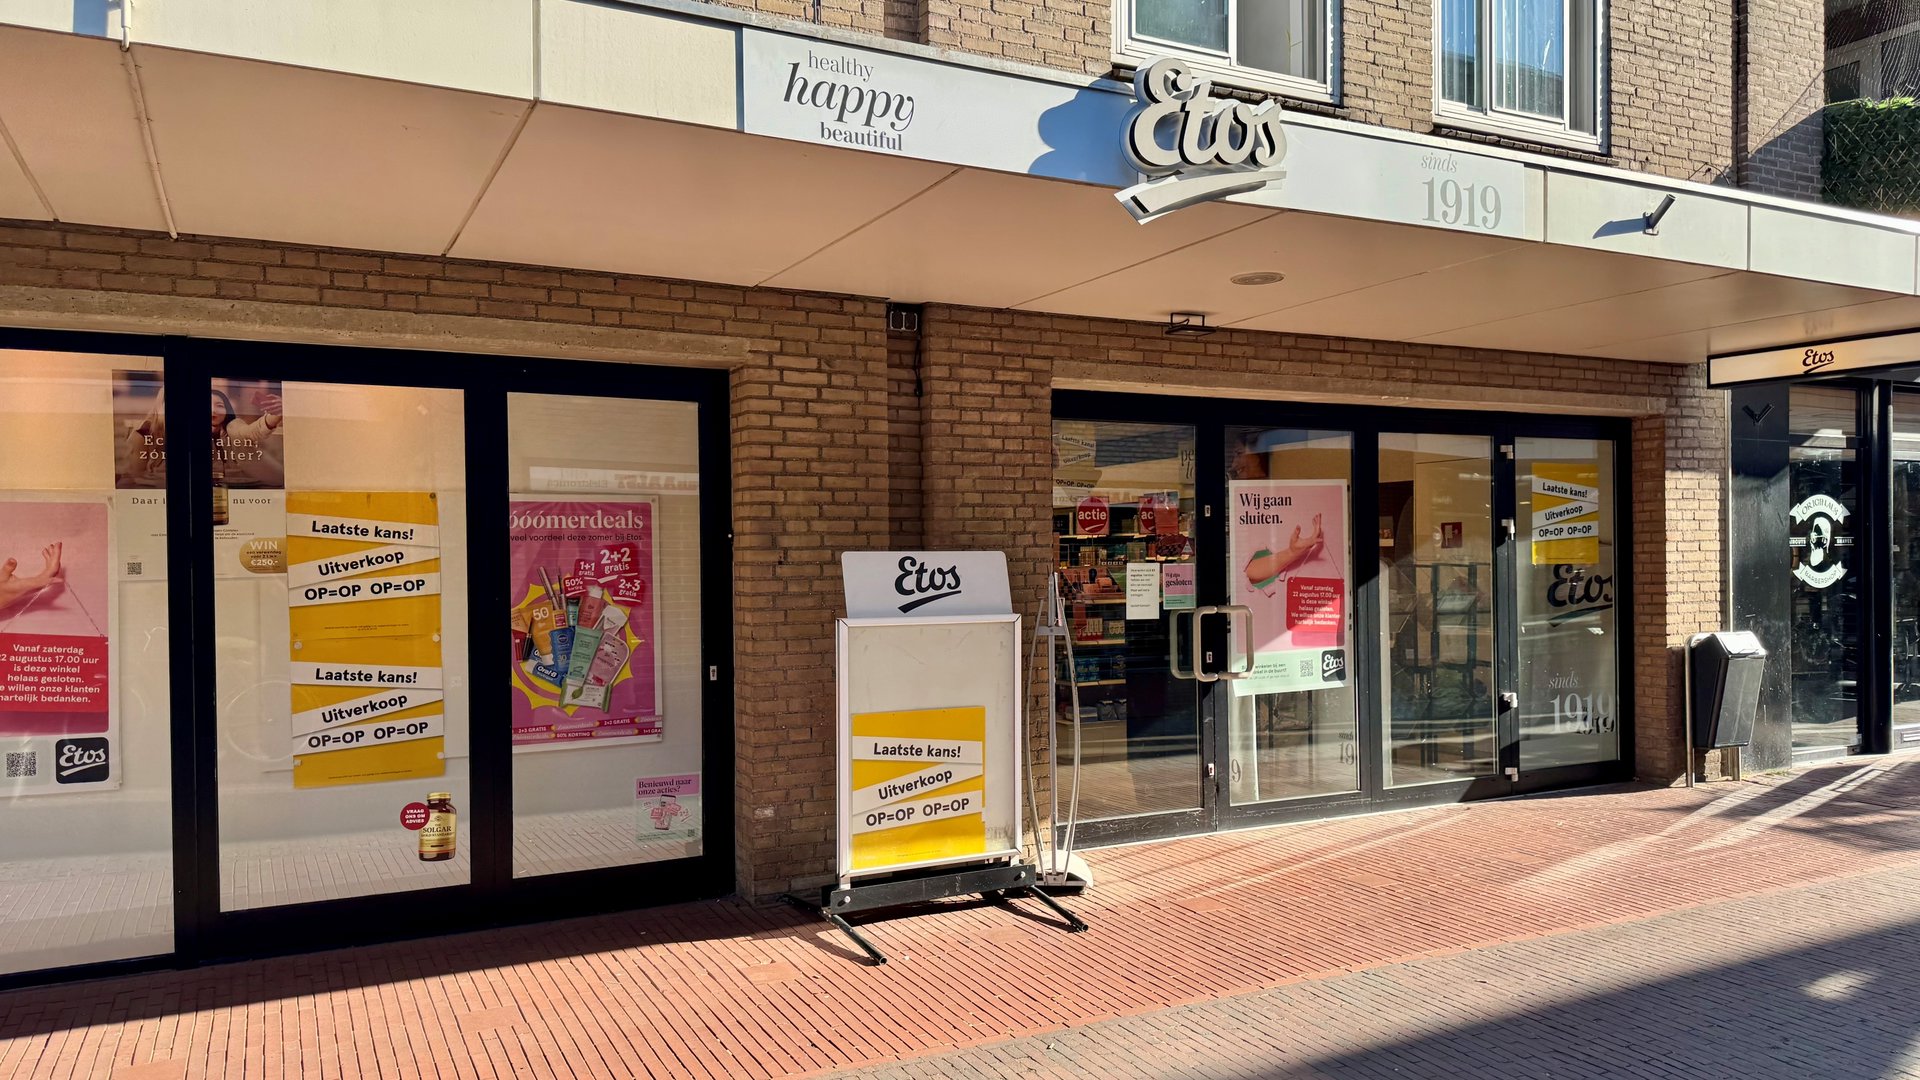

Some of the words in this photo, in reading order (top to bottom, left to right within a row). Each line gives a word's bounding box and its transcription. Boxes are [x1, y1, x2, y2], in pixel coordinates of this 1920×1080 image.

[808, 50, 874, 82] healthy
[784, 62, 915, 132] happy
[1120, 55, 1288, 175] Etos
[820, 122, 903, 151] beautiful
[1421, 152, 1458, 173] sinds
[1422, 177, 1502, 230] 1919
[1802, 349, 1835, 369] Etos
[1542, 482, 1568, 495] Laatste
[1569, 486, 1588, 498] kans!
[1239, 493, 1261, 511] Wij
[1263, 494, 1292, 511] gaan
[510, 509, 644, 530] óóómerdeals
[1078, 508, 1107, 520] actie
[1239, 510, 1283, 525] sluiten.
[1544, 504, 1583, 521] Uitverkoop
[311, 520, 370, 537] Laatste
[374, 526, 415, 541] kans!
[529, 534, 565, 542] voordeel
[615, 533, 624, 542] bij
[1538, 526, 1564, 538] OP=OP
[1567, 524, 1592, 536] OP=OP
[250, 541, 278, 550] WIN
[318, 550, 404, 576] Uitverkoop
[600, 548, 631, 564] 2+2
[580, 561, 595, 571] 1+1
[604, 562, 630, 574] gratis
[565, 578, 583, 587] 50%
[894, 555, 961, 596] Etos
[1165, 579, 1192, 588] gesloten
[304, 584, 362, 601] OP=OP
[370, 578, 426, 595] OP=OP
[619, 579, 640, 591] 2+3
[533, 607, 549, 620] 50
[13, 644, 40, 653] Vanaf
[42, 646, 84, 656] zaterdag
[10, 655, 52, 664] augustus
[55, 656, 80, 664] 17.00
[1323, 654, 1344, 670] Etos
[13, 664, 21, 672] is
[24, 664, 47, 672] deze
[49, 665, 80, 673] winkel
[315, 668, 373, 683] Laatste
[377, 670, 418, 684] kans!
[537, 666, 558, 678] Oral-B
[7, 674, 38, 682] helaas
[41, 675, 84, 684] gesloten.
[1548, 671, 1578, 689] sinds
[8, 684, 36, 692] willen
[65, 685, 100, 693] klanten
[41, 695, 91, 703] bedanken.
[321, 694, 408, 724] Uitverkoop
[1549, 690, 1615, 734] 1919
[308, 730, 365, 748] OP=OP
[374, 722, 429, 740] OP=OP
[59, 744, 106, 767] Etos
[873, 742, 923, 758] Laatste
[927, 744, 961, 758] kans!
[638, 779, 674, 789] Benieuwd
[657, 786, 681, 794] acties?
[878, 769, 953, 801] Uitverkoop
[865, 806, 915, 828] OP=OP
[922, 797, 970, 817] OP=OP
